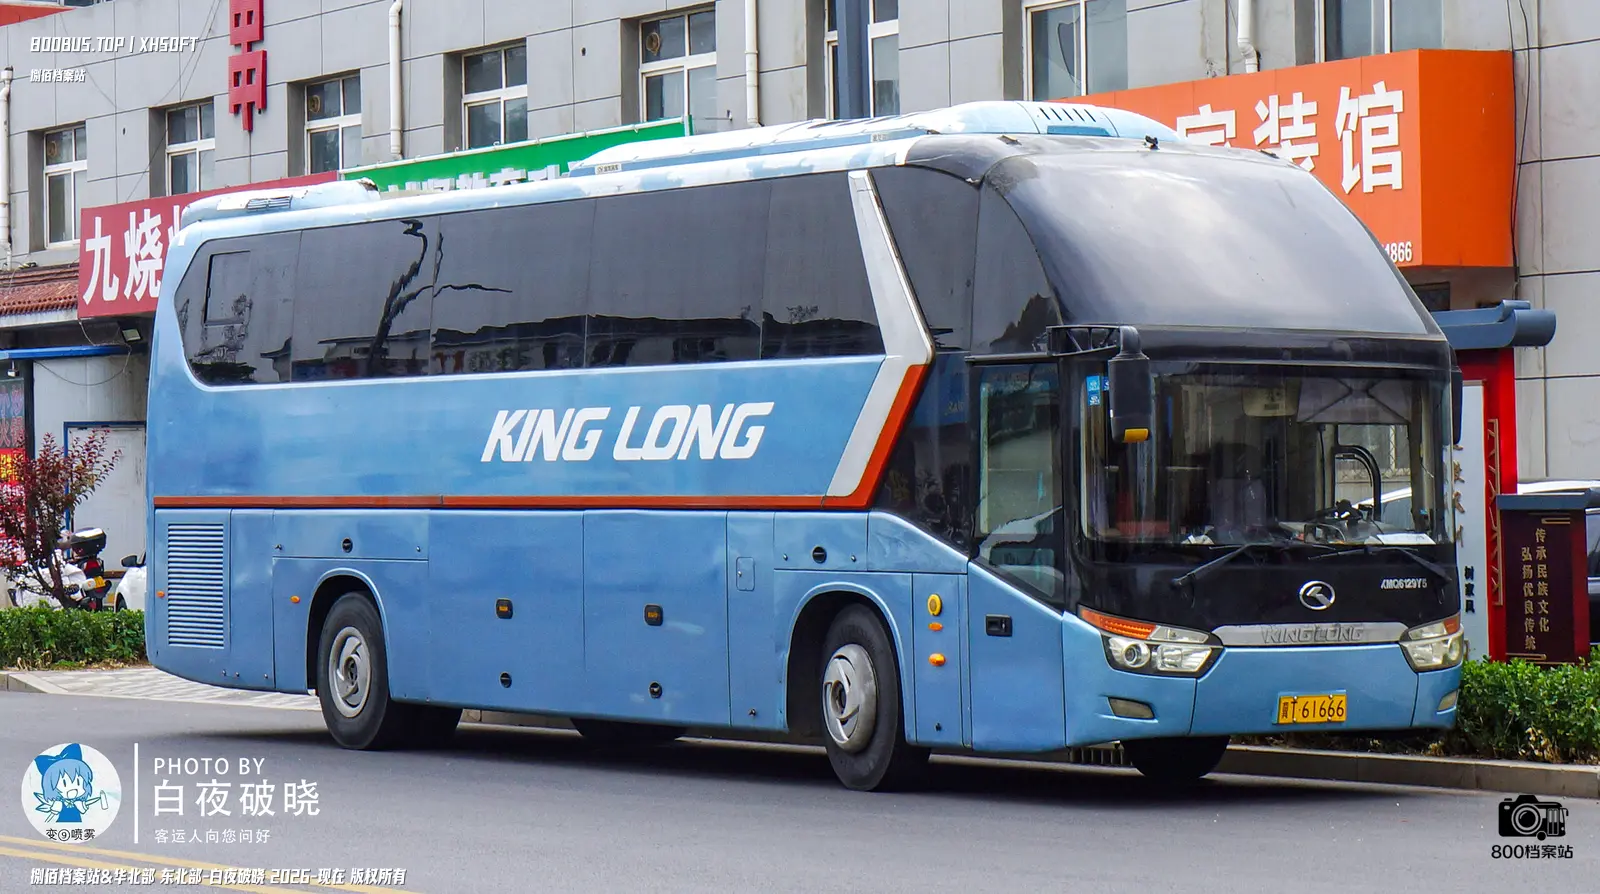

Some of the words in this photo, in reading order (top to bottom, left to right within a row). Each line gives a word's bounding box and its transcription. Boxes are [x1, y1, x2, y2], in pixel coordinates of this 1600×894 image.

[83, 205, 180, 305] 九烧
[480, 406, 611, 462] KING
[612, 401, 775, 461] LONG
[1521, 546, 1537, 651] 弘扬优良传统
[1535, 527, 1550, 633] 传承民族文化
